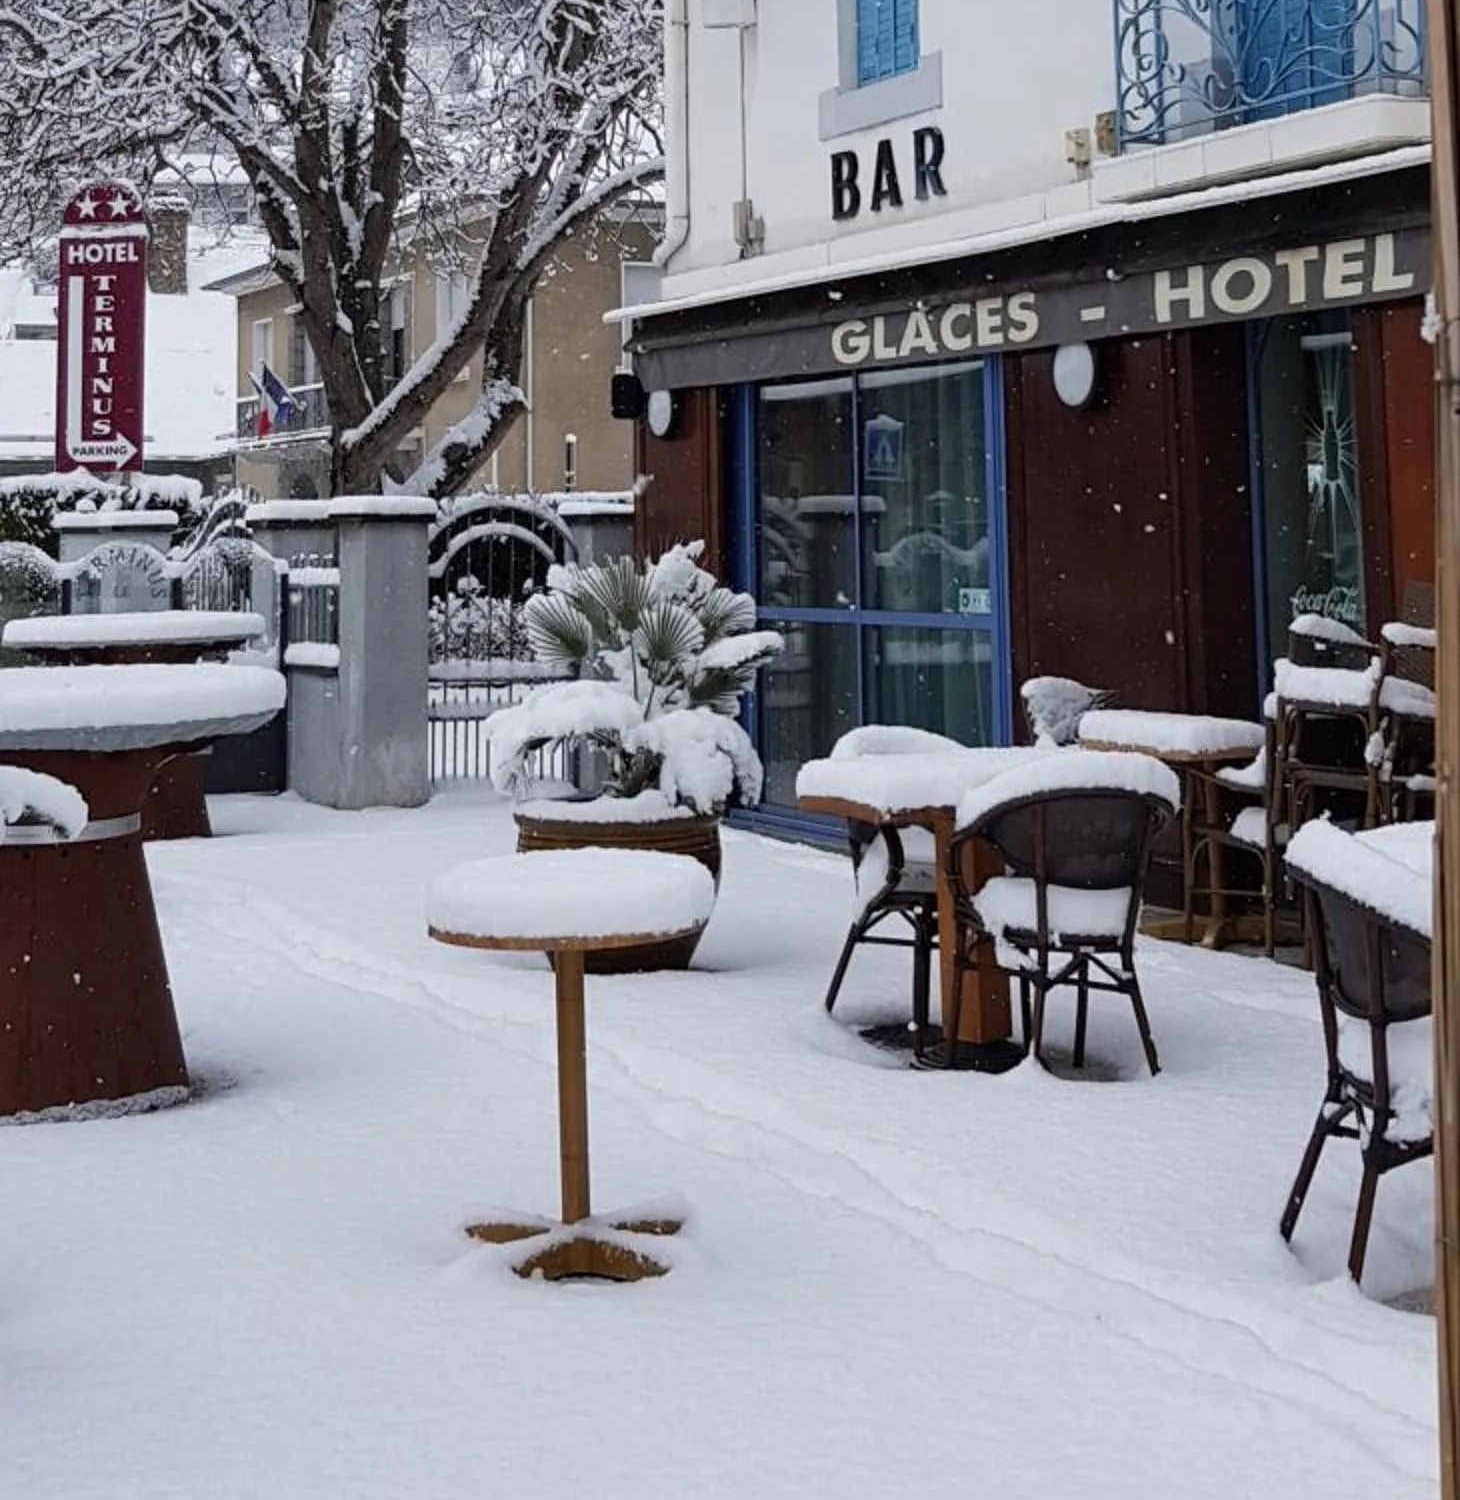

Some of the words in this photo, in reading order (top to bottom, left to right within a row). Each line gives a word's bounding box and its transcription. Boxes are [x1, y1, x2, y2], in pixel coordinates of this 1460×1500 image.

[830, 126, 947, 221] BAR
[68, 243, 138, 264] HOTEL
[1154, 233, 1414, 323] HOTEL
[92, 275, 117, 435] TERMINUS
[72, 445, 128, 456] PARKING
